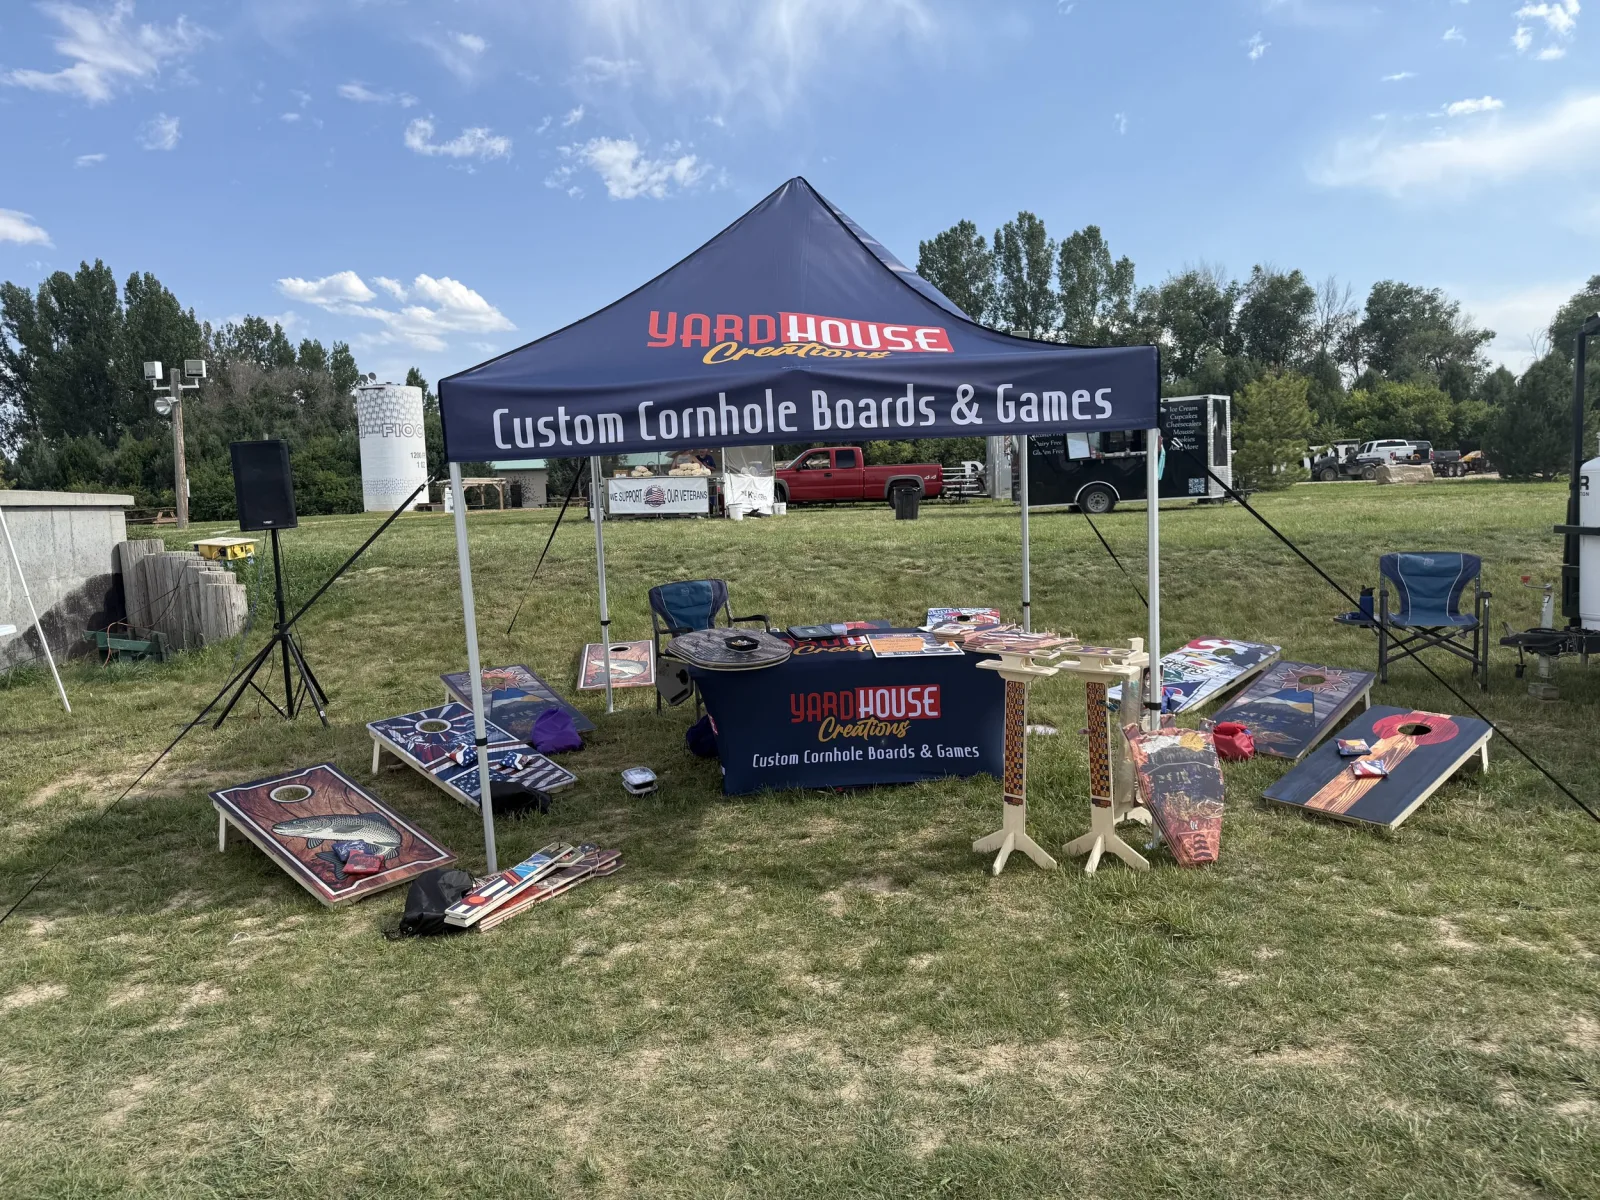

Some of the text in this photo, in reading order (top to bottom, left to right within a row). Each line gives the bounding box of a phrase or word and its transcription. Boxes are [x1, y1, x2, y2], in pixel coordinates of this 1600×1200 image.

[647, 310, 949, 352] YARDHOUSE
[702, 341, 893, 365] Creations
[492, 383, 1112, 449] Custom Cornhole Boards & Games
[1170, 413, 1198, 421] Cupcakes
[610, 492, 618, 501] WE
[619, 489, 643, 503] SUPPORT
[667, 489, 679, 503] OUR
[679, 490, 708, 502] VETERANS
[790, 686, 939, 723] YARDHOUSE
[818, 716, 912, 742] Creations
[752, 743, 980, 768] Custom Cornhole Boards & Games
